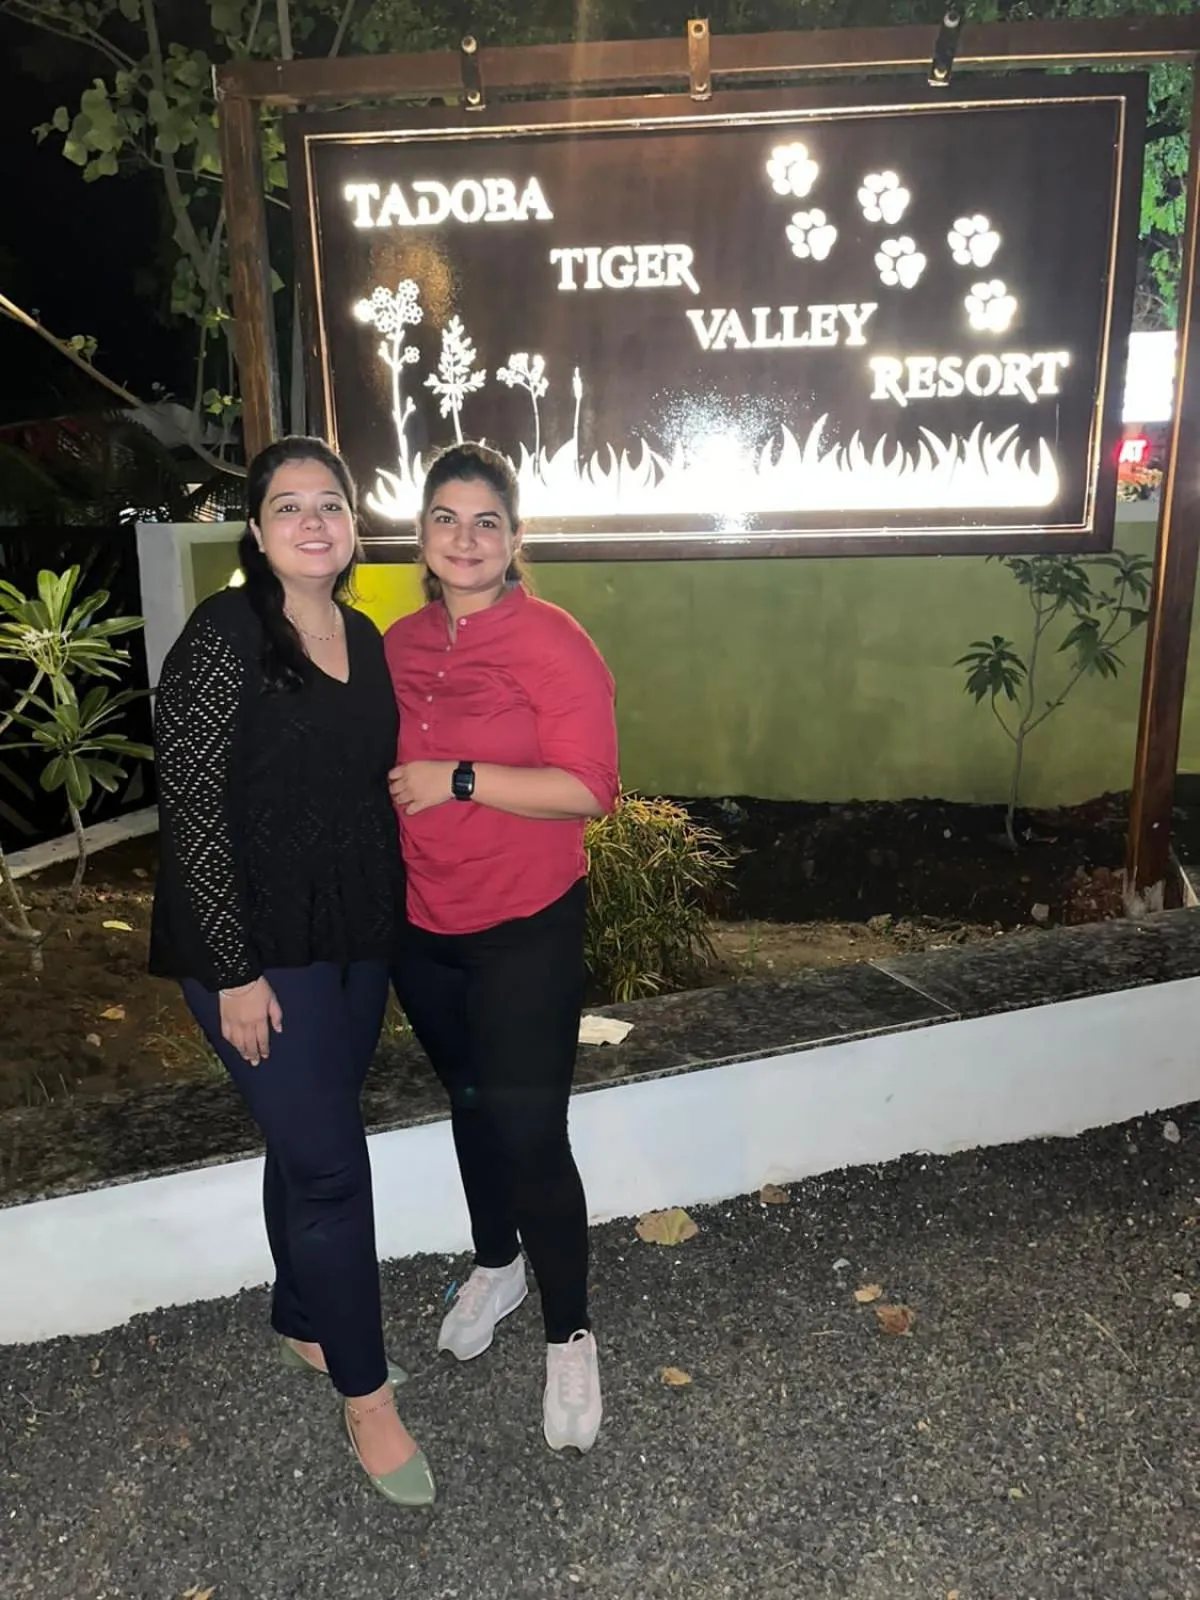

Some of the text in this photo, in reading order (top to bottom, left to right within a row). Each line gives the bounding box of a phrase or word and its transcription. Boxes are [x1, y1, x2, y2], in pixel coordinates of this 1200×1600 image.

[343, 176, 554, 228] TADOBA
[550, 244, 700, 294] TIGER
[686, 302, 878, 350] VALLEY
[869, 351, 1071, 407] RESORT
